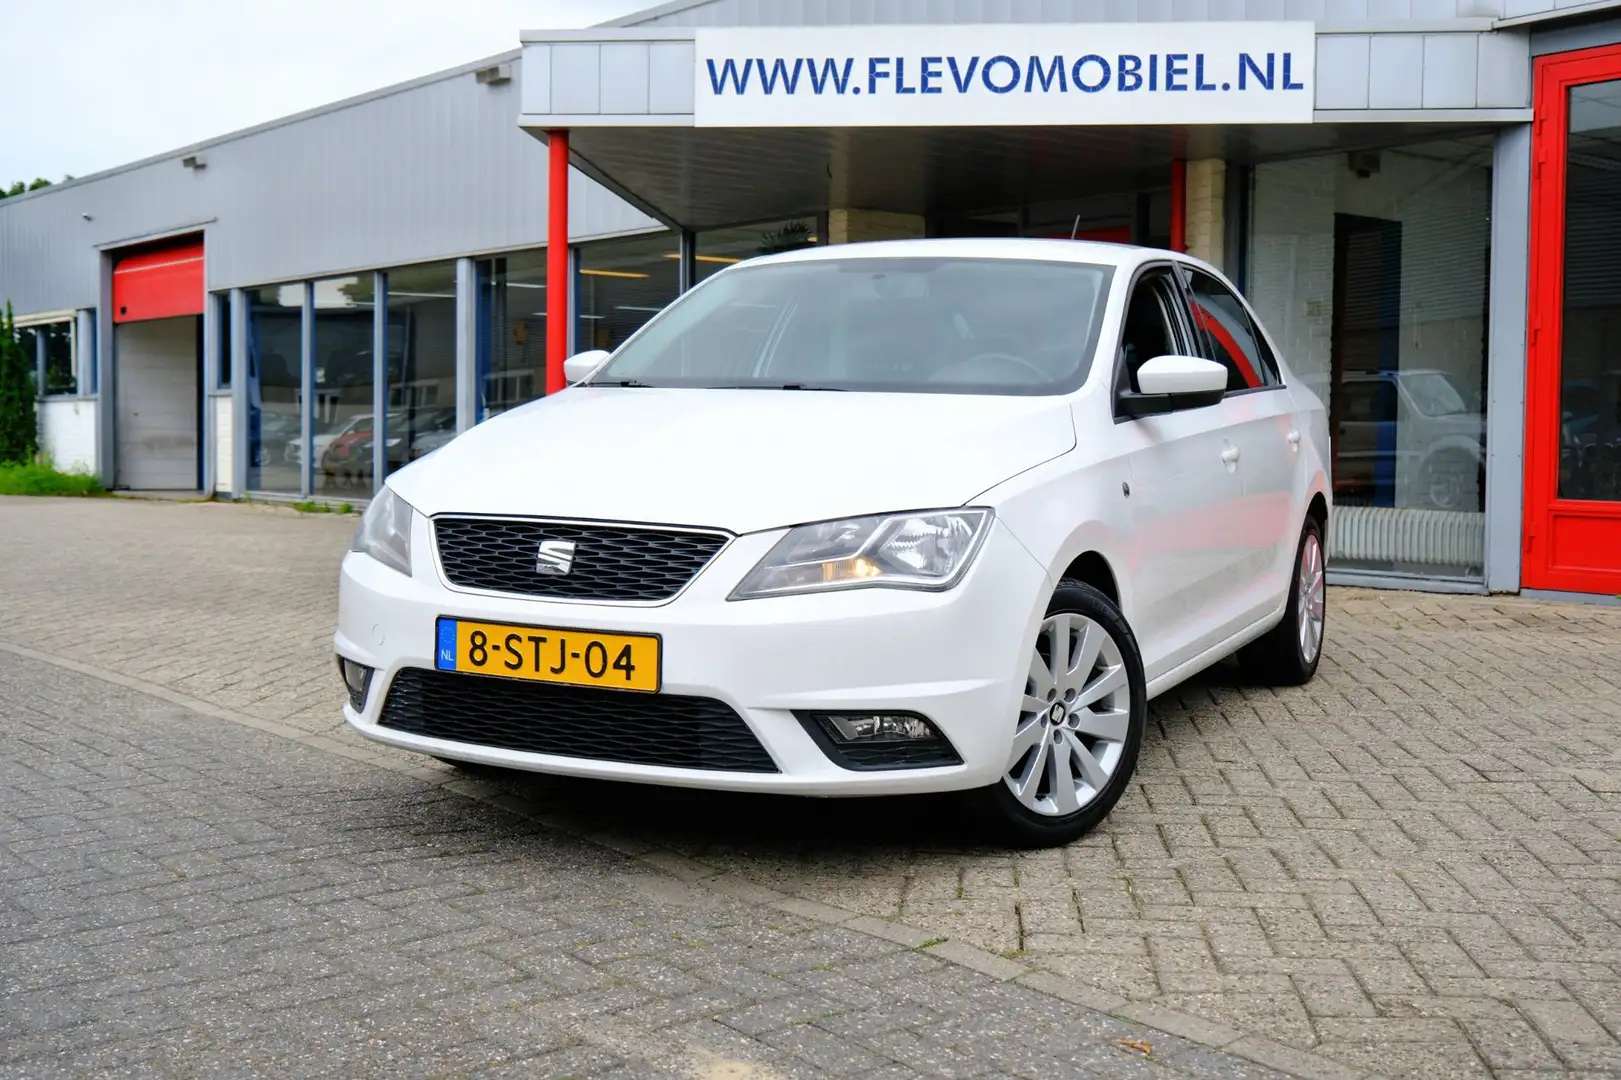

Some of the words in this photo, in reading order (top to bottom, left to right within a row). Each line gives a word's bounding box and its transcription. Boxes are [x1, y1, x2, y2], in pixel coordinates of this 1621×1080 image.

[706, 52, 1304, 95] WWW.FLEVOMOBIEL.NL
[441, 649, 454, 661] NL
[469, 630, 635, 680] 8-STJ-04
